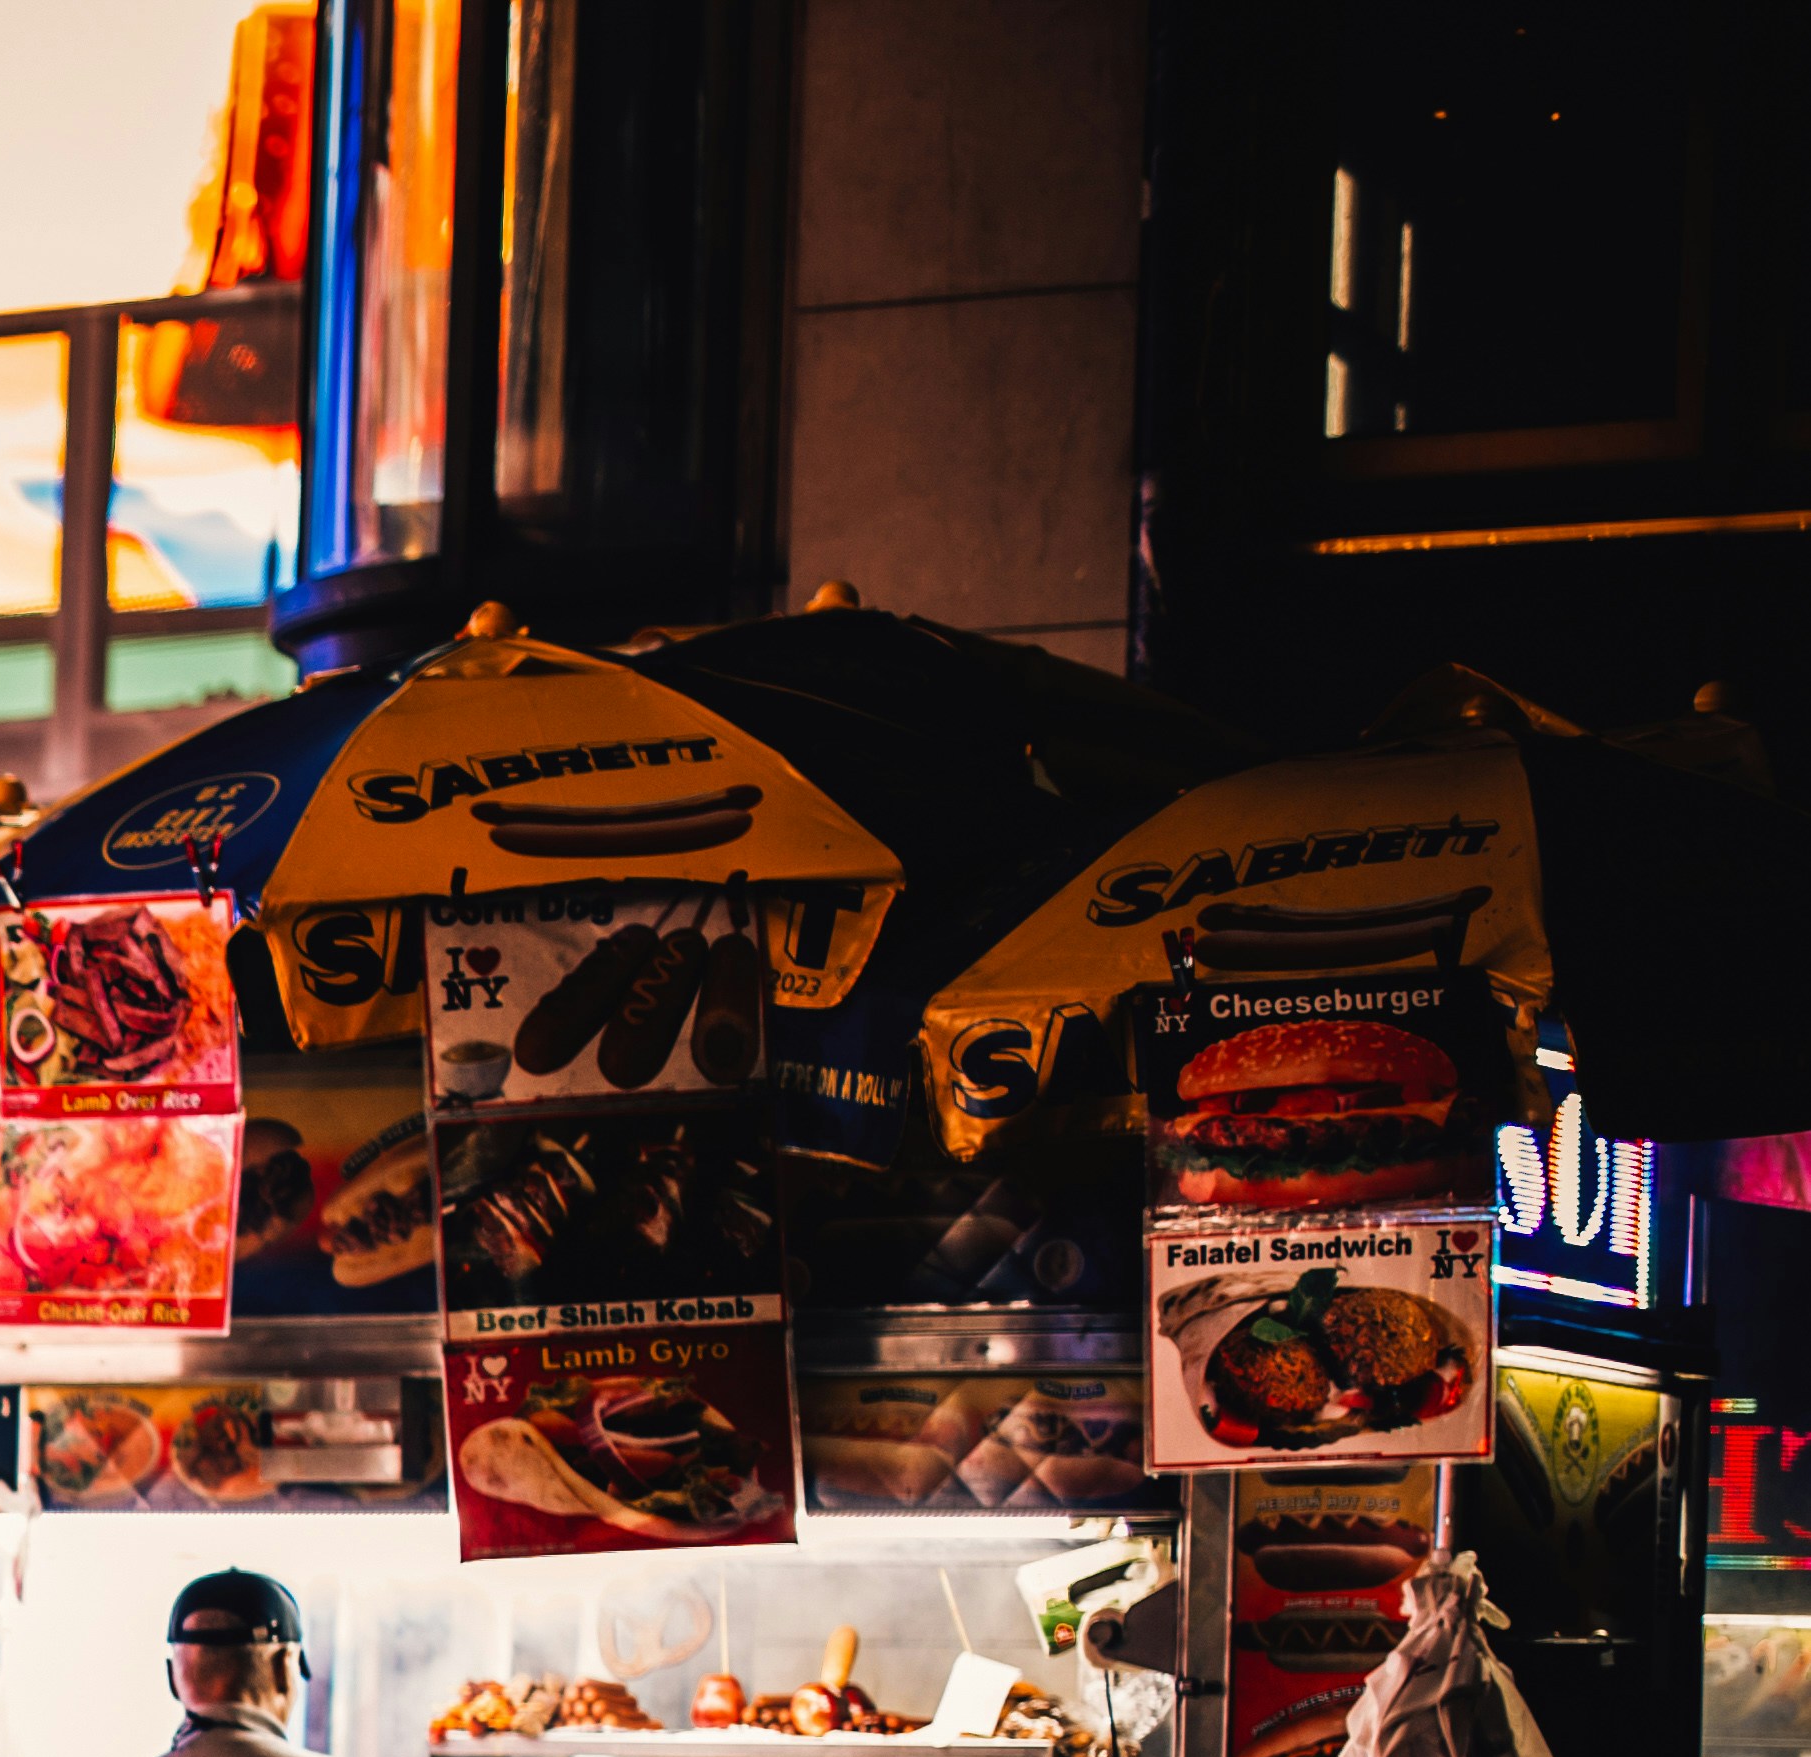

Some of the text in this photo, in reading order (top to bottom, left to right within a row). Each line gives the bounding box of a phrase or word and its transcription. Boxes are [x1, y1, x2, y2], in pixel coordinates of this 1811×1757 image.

[346, 732, 718, 825] SABRETT
[1087, 819, 1500, 927] SABRETT
[538, 892, 616, 926] Dog
[441, 976, 510, 1012] NY
[1209, 987, 1445, 1019] Cheeseburger
[1154, 1014, 1191, 1034] NY
[61, 1091, 112, 1113] Lamb
[116, 1089, 158, 1111] Over
[161, 1088, 202, 1109] Rice
[1167, 1233, 1413, 1266] Falafel Sandwich
[1436, 1230, 1451, 1254] I
[1430, 1253, 1484, 1279] NY
[37, 1299, 105, 1322] Chicken
[477, 1297, 755, 1333] Beef Shish Kebab
[541, 1337, 731, 1371] Lamb Gyro
[462, 1377, 514, 1405] NY
